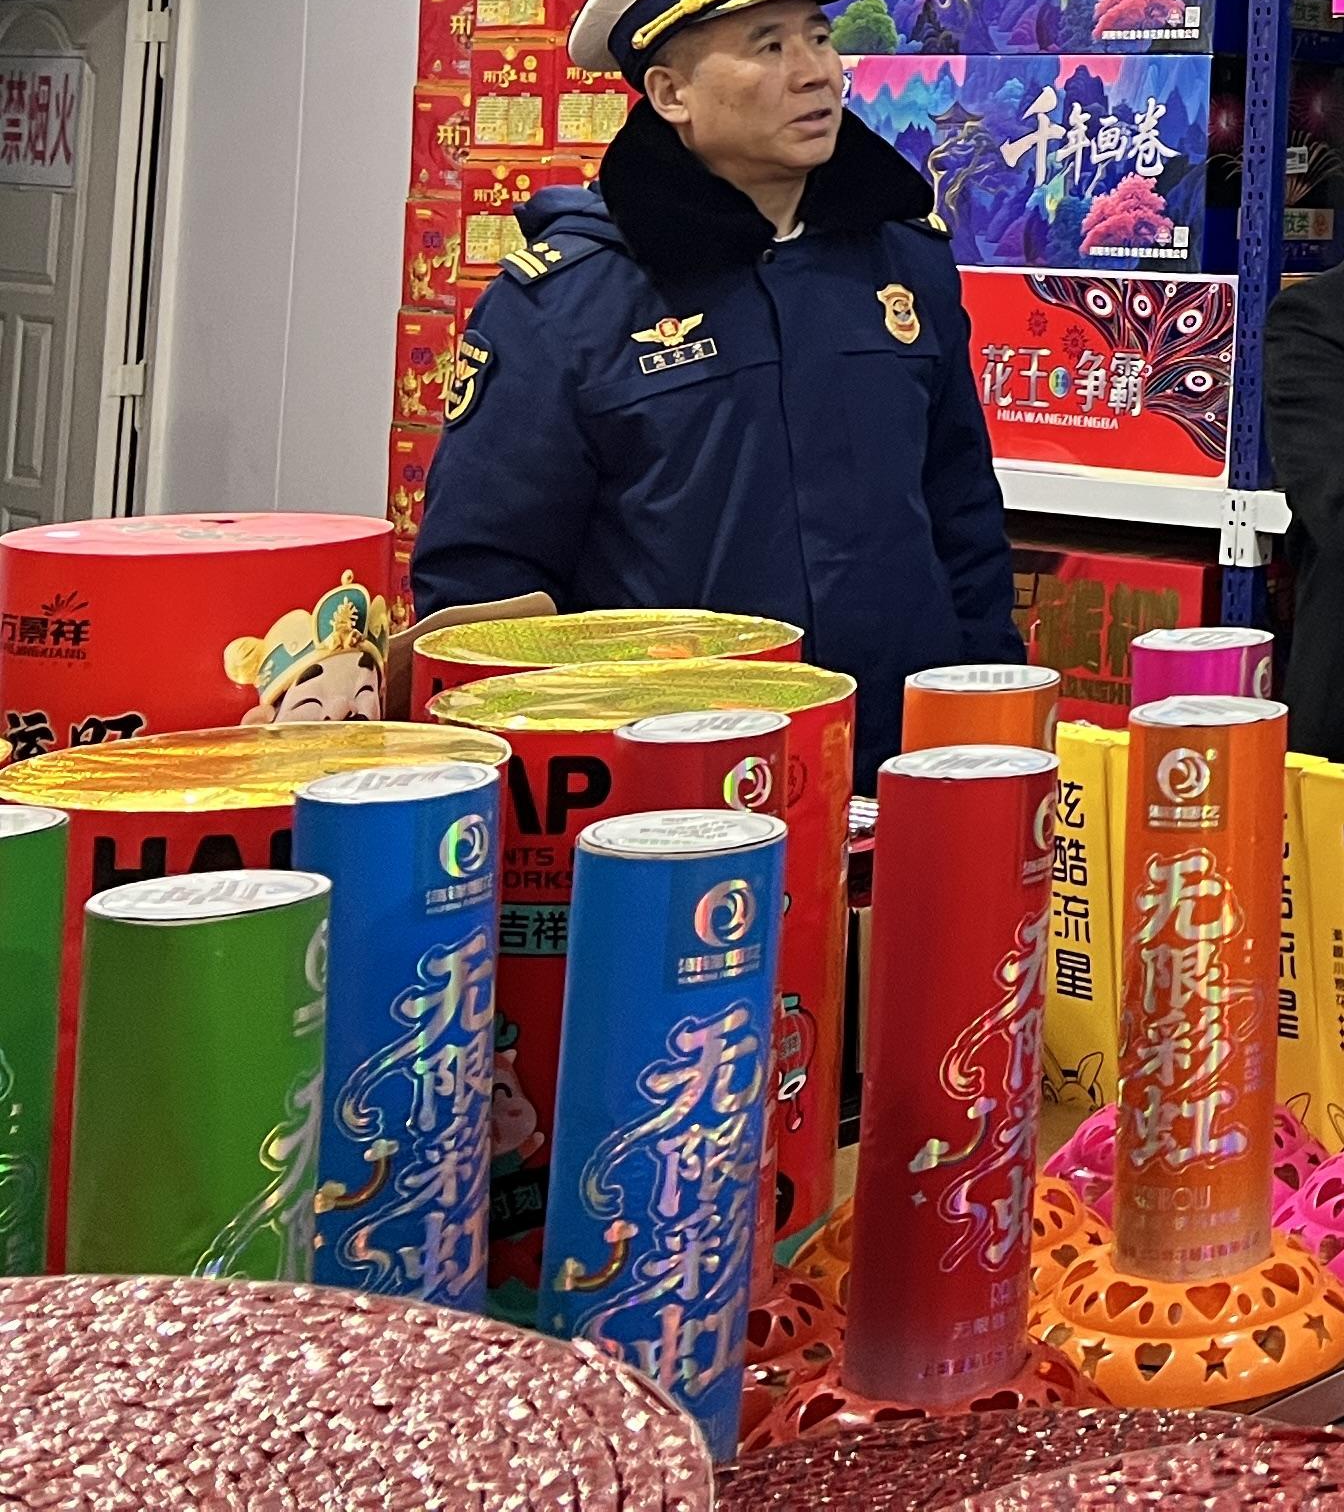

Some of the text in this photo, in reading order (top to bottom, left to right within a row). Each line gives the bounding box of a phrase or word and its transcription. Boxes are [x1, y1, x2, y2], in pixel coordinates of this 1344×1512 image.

[0, 70, 74, 167] 禁烟火
[1000, 86, 1182, 187] 千年画卷
[997, 409, 1119, 430] HUAWANGZHENGBA
[1132, 848, 1248, 1170] 无限彩虹
